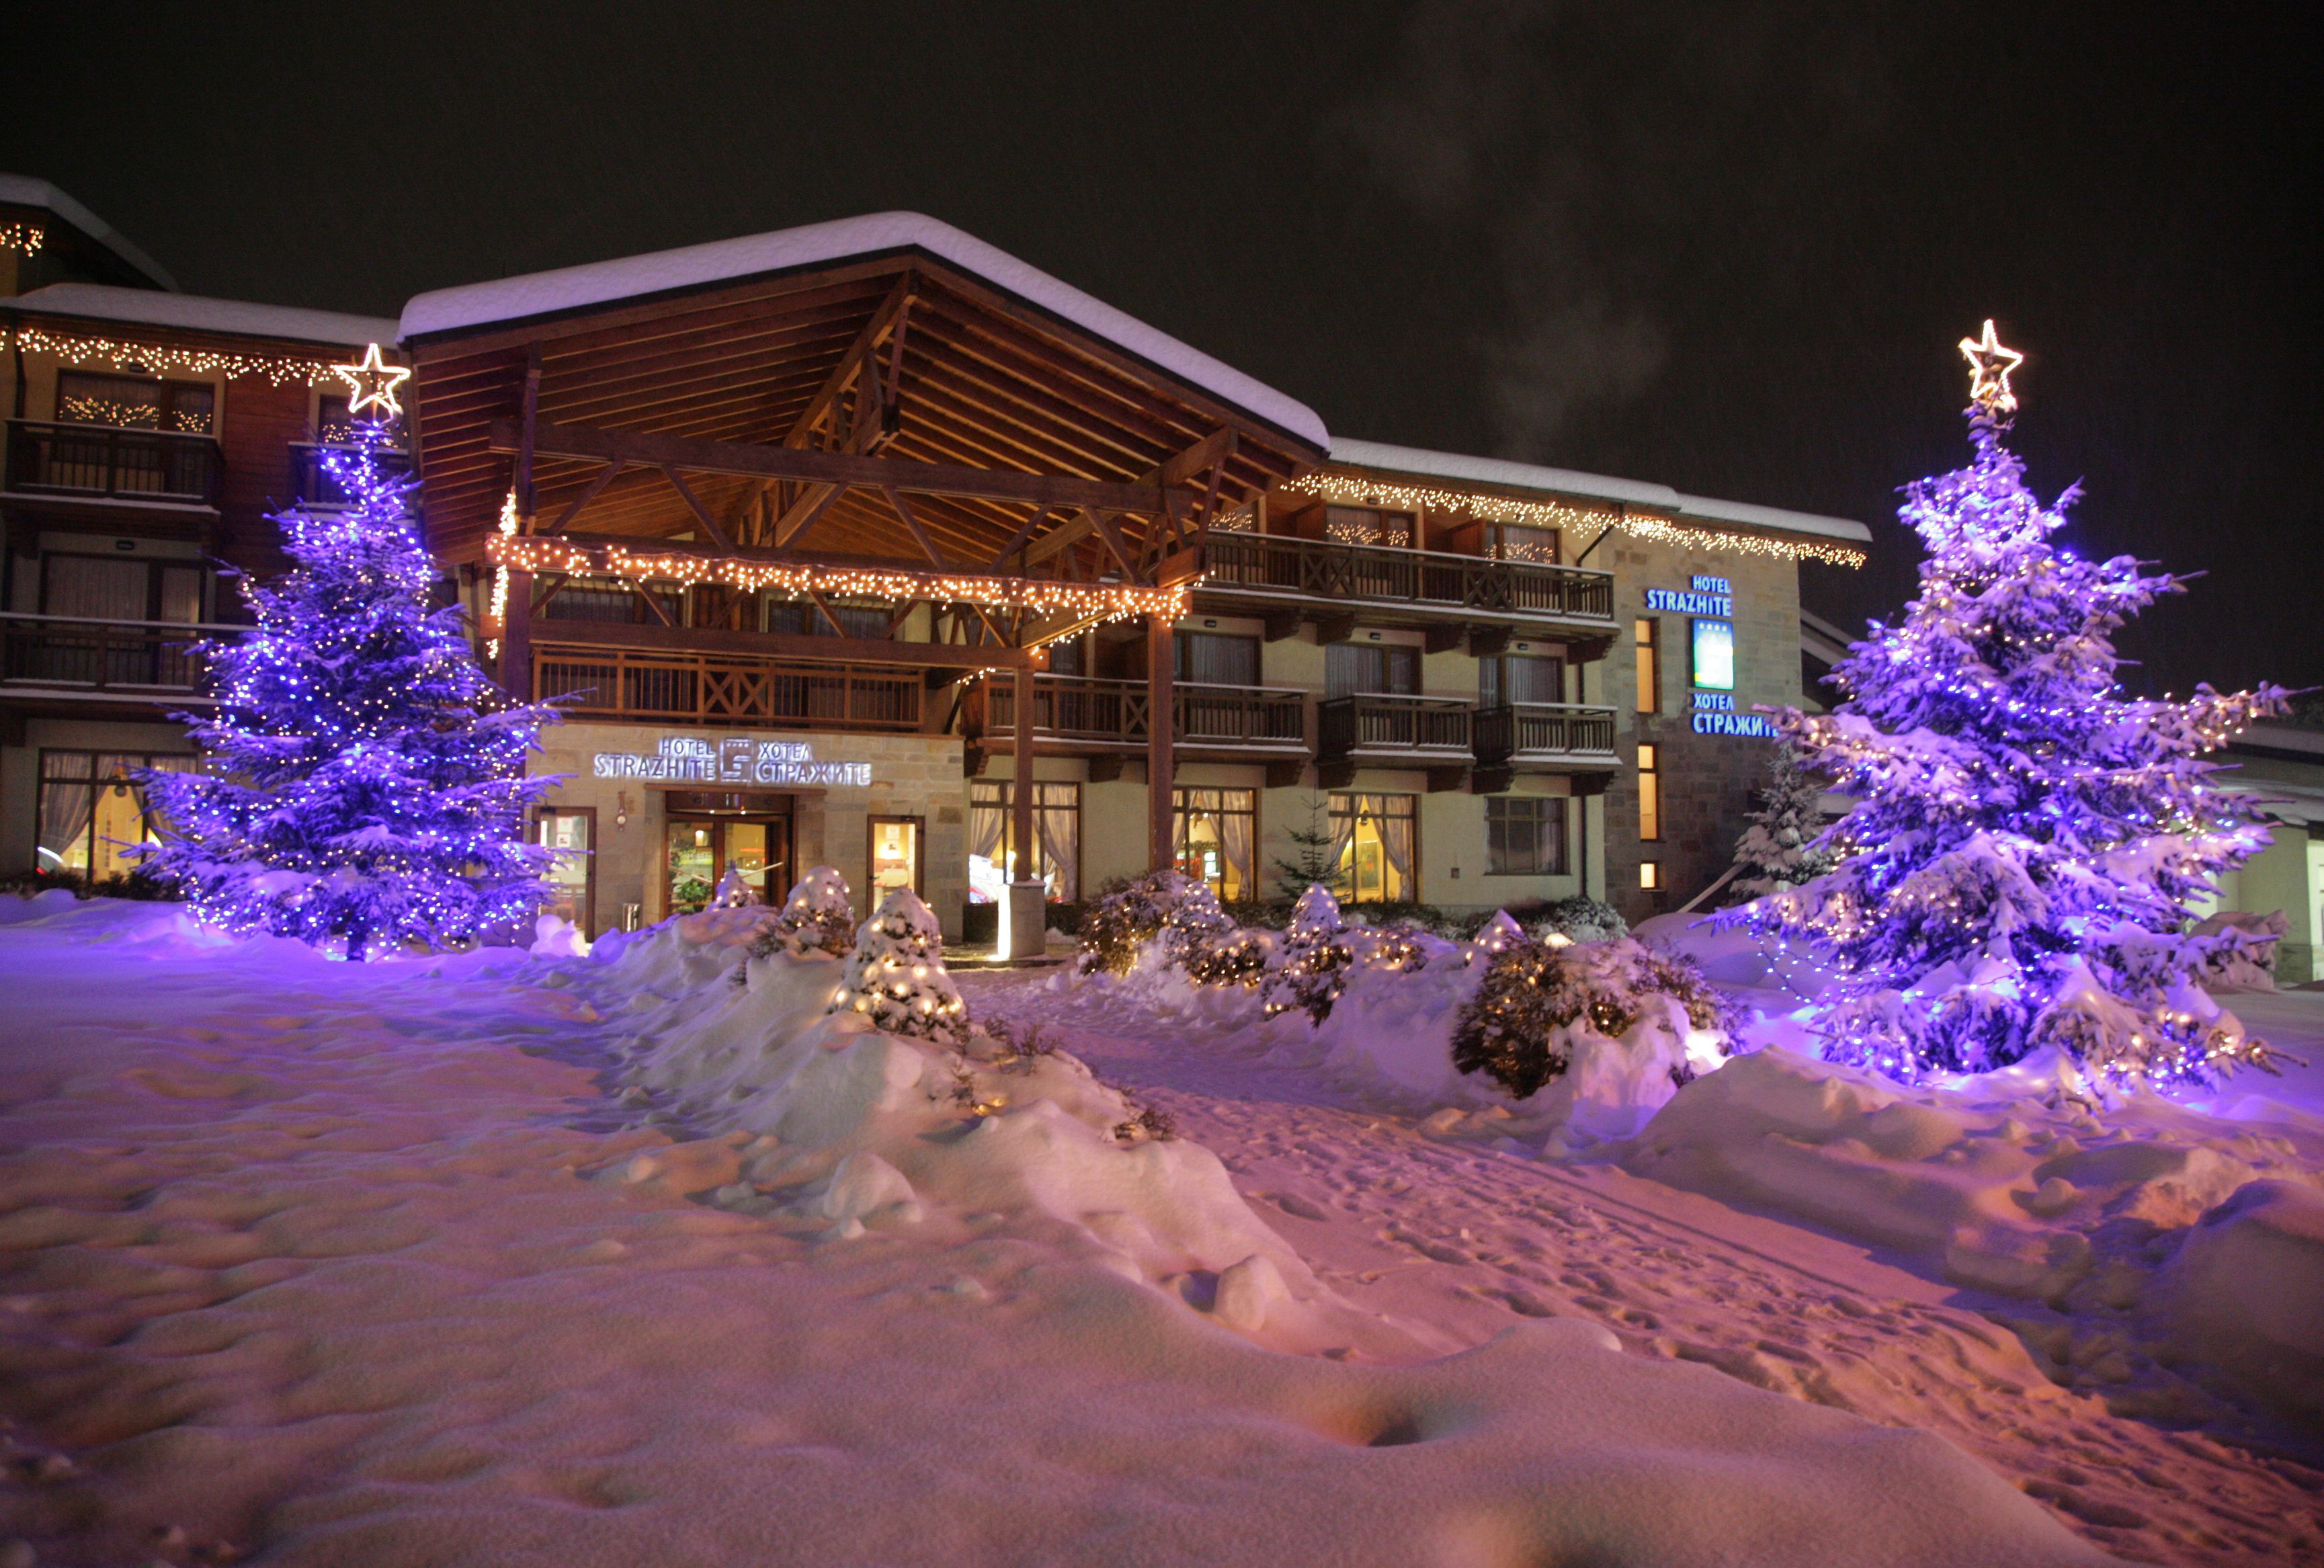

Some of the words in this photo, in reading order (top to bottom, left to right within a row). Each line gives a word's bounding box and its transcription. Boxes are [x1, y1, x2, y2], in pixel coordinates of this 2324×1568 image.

[1692, 575, 1731, 593] HOTEL
[1647, 589, 1732, 616] STRAZHITE
[1693, 693, 1735, 710] ХОТЕЛ
[659, 737, 715, 757] HOTEL
[758, 742, 811, 761] ХОТЕЛ
[595, 753, 716, 780] STRAZHITE
[755, 761, 872, 785] СТРАЖИТЕ
